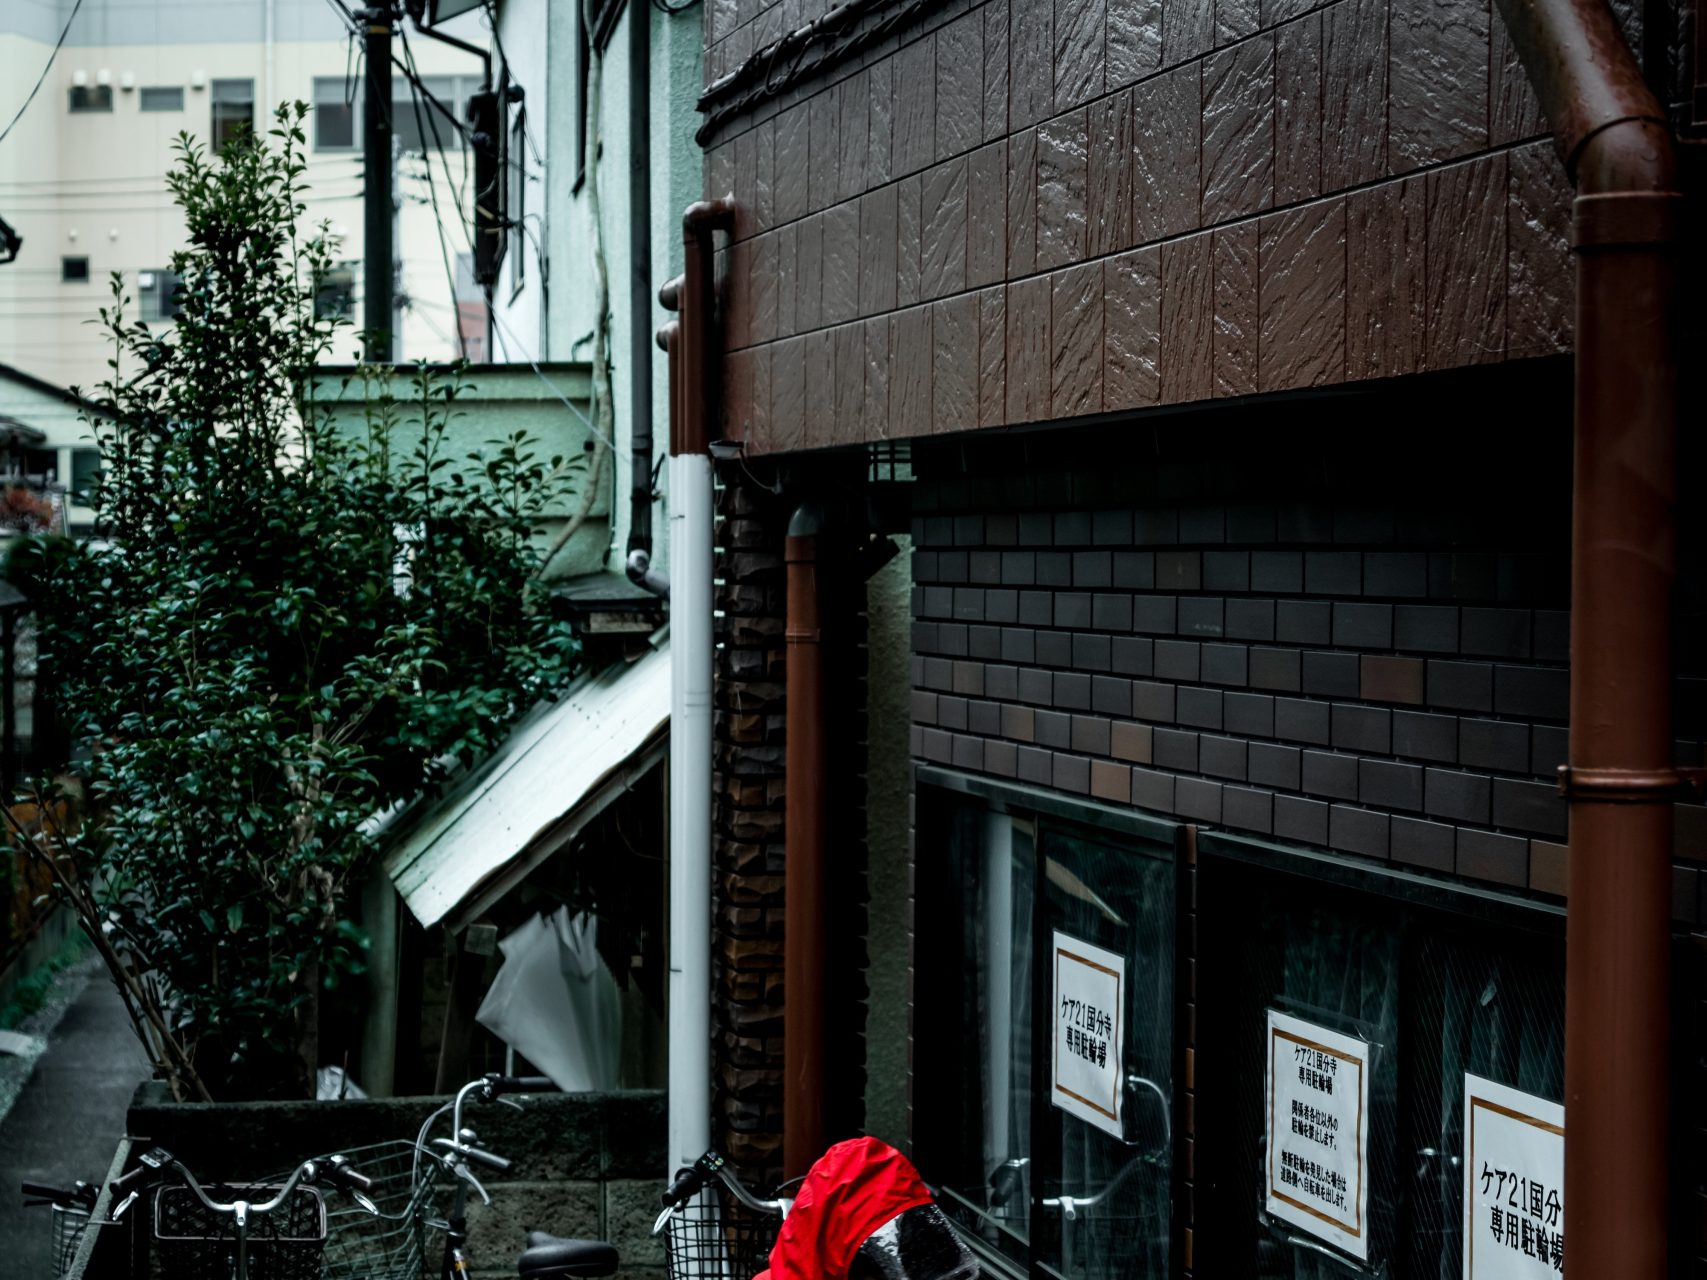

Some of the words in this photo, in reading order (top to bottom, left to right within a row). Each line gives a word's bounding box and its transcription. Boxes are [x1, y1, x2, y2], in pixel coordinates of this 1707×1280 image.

[1061, 994, 1112, 1041] ケア21国分寺
[1065, 1025, 1108, 1069] 専用駐輪場
[1294, 1045, 1337, 1076] ケア21国分寺
[1298, 1065, 1333, 1096] 専用駐輪場
[1480, 1161, 1564, 1227] ケア21国分
[1489, 1205, 1564, 1274] 専用駐輪場
